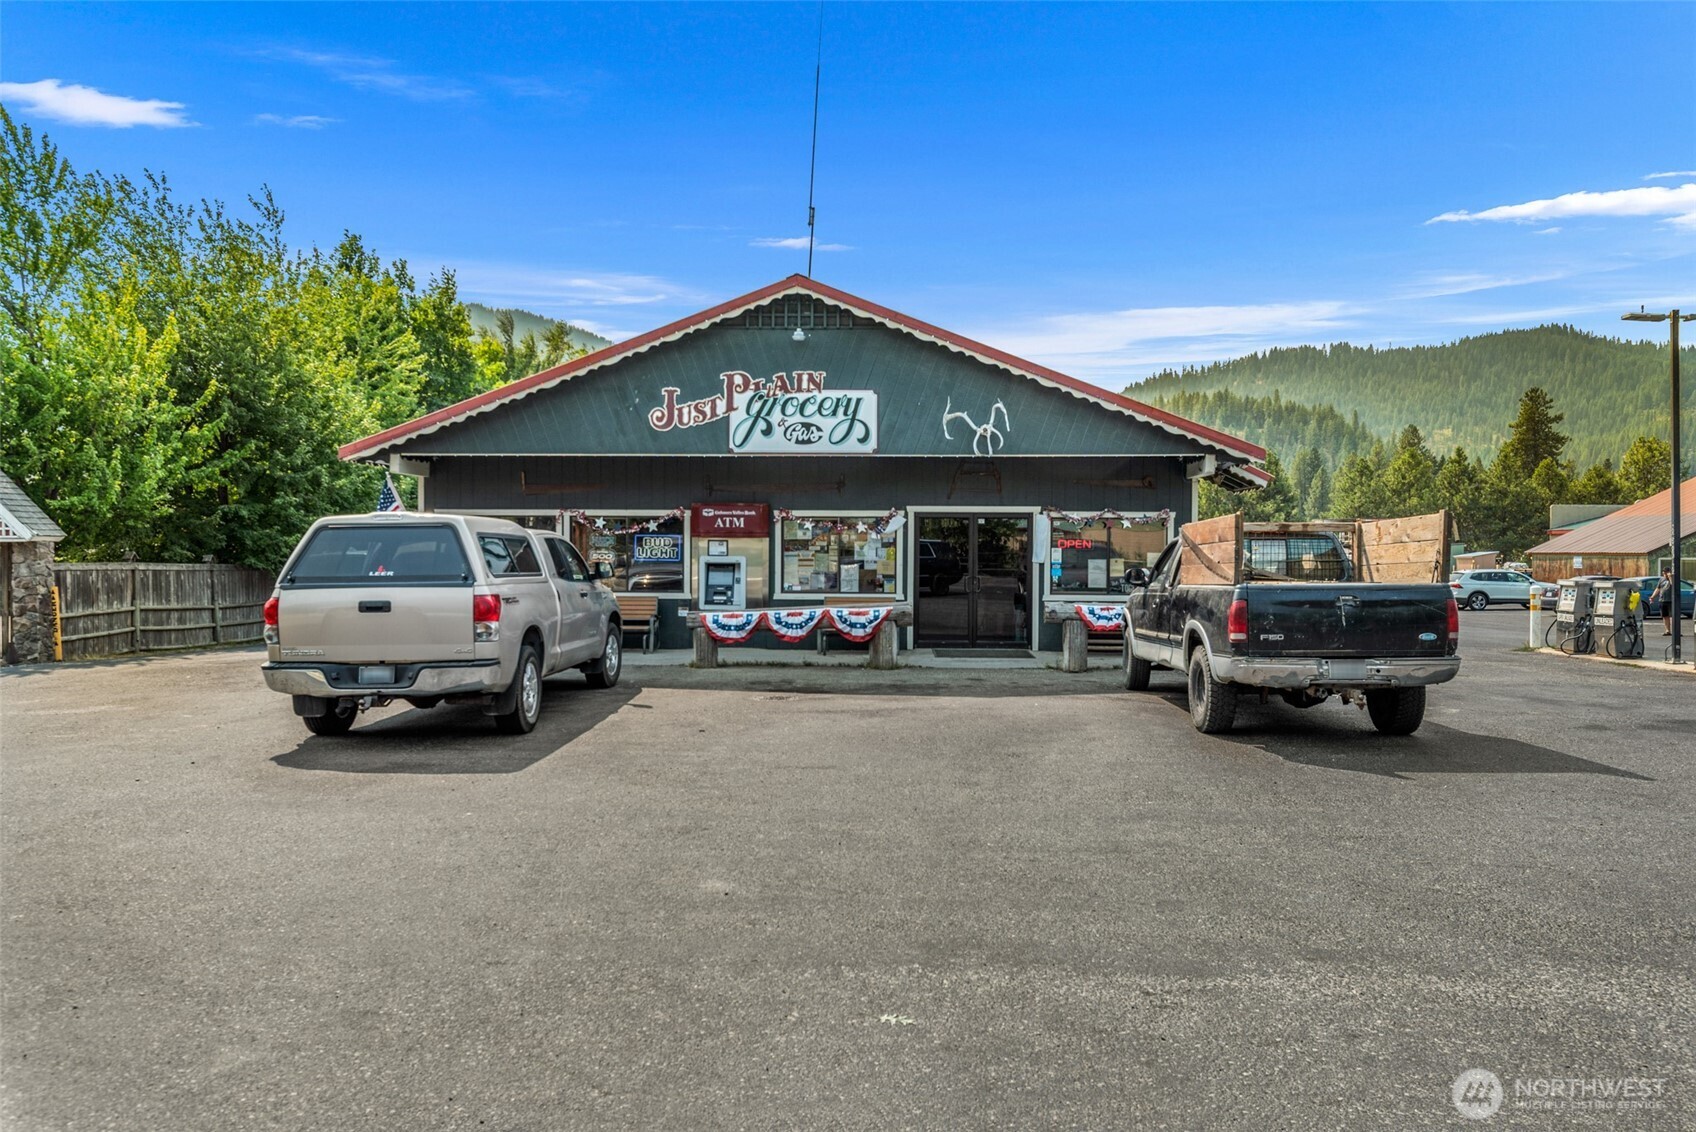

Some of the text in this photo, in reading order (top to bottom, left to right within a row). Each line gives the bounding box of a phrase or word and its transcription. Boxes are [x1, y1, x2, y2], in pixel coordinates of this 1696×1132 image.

[785, 423, 825, 443] Gas
[714, 517, 745, 528] ATM
[642, 537, 673, 548] BUD
[1057, 539, 1092, 549] OPEN
[636, 547, 678, 559] LIGHT
